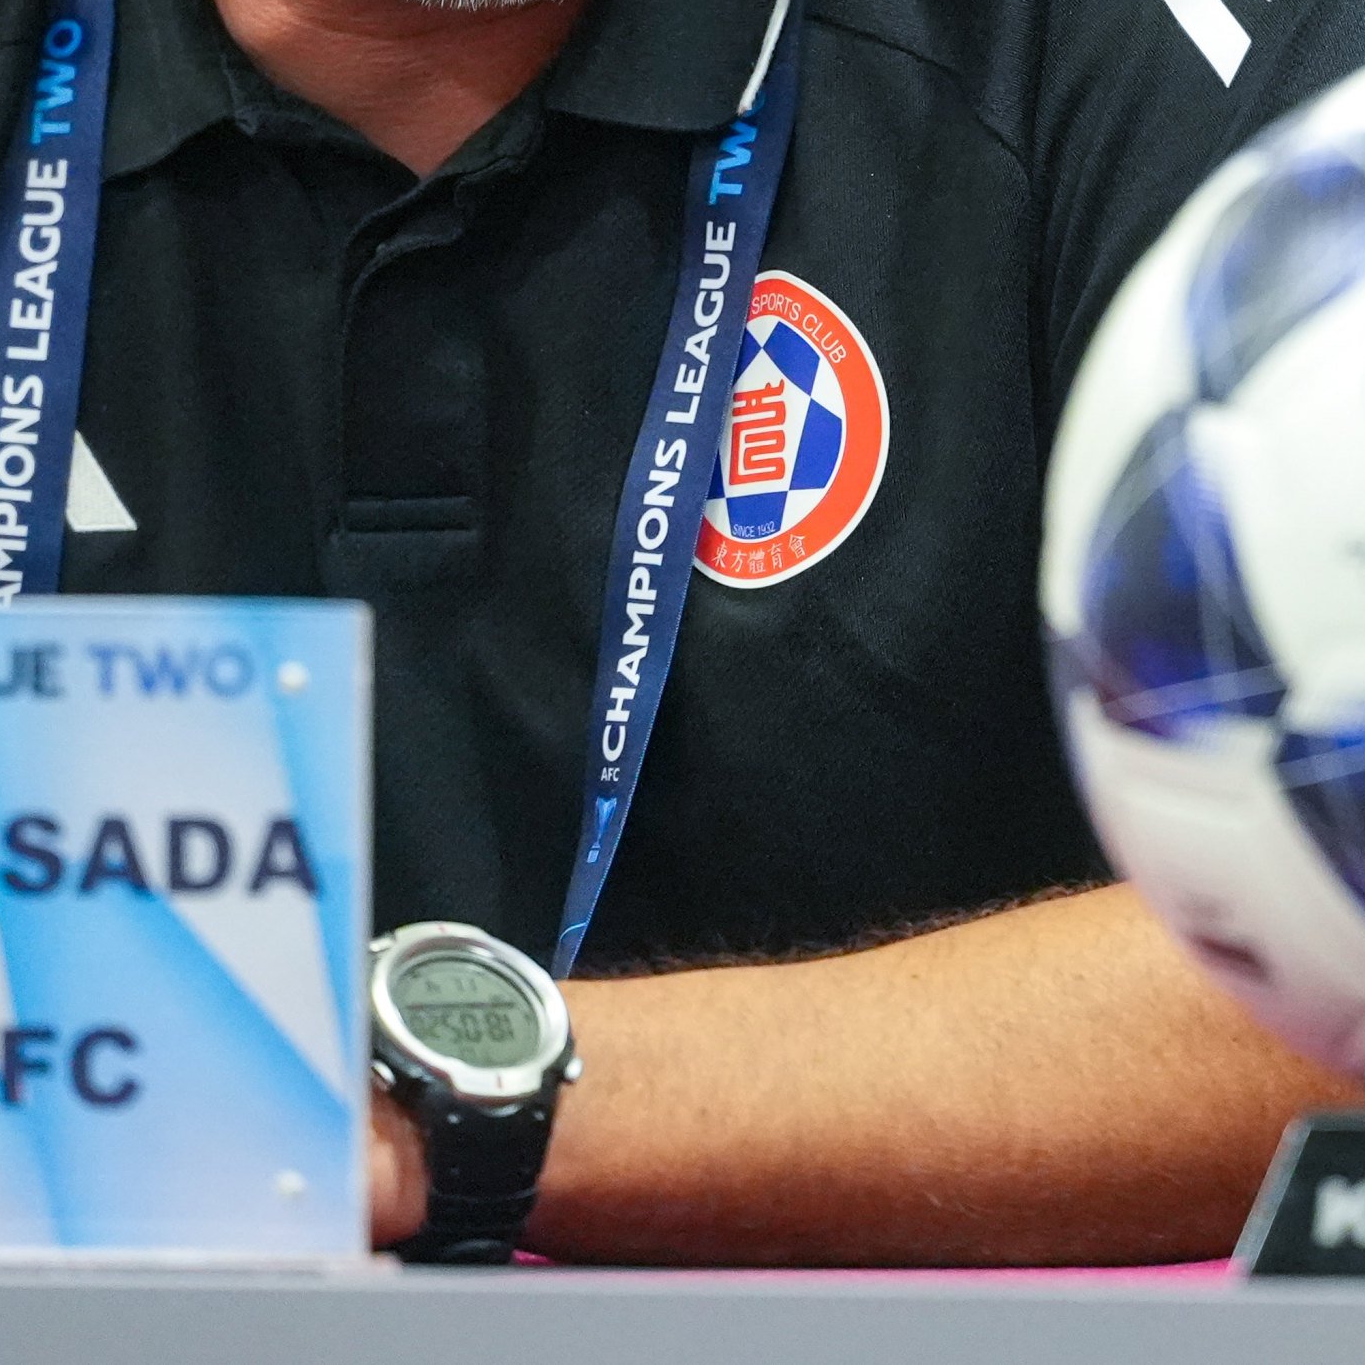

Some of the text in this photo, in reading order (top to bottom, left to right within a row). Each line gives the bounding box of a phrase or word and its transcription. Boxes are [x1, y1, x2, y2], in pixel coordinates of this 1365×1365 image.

[31, 19, 83, 145] TWO
[7, 157, 69, 363] LEAGUE
[665, 220, 737, 425] LEAGUE
[750, 292, 848, 366] SPORTS CLUB
[732, 523, 756, 538] SINCE
[602, 438, 688, 763] CHAMPIONS
[87, 640, 257, 699] TWO
[600, 765, 621, 783] AFC
[0, 1021, 145, 1109] FC
